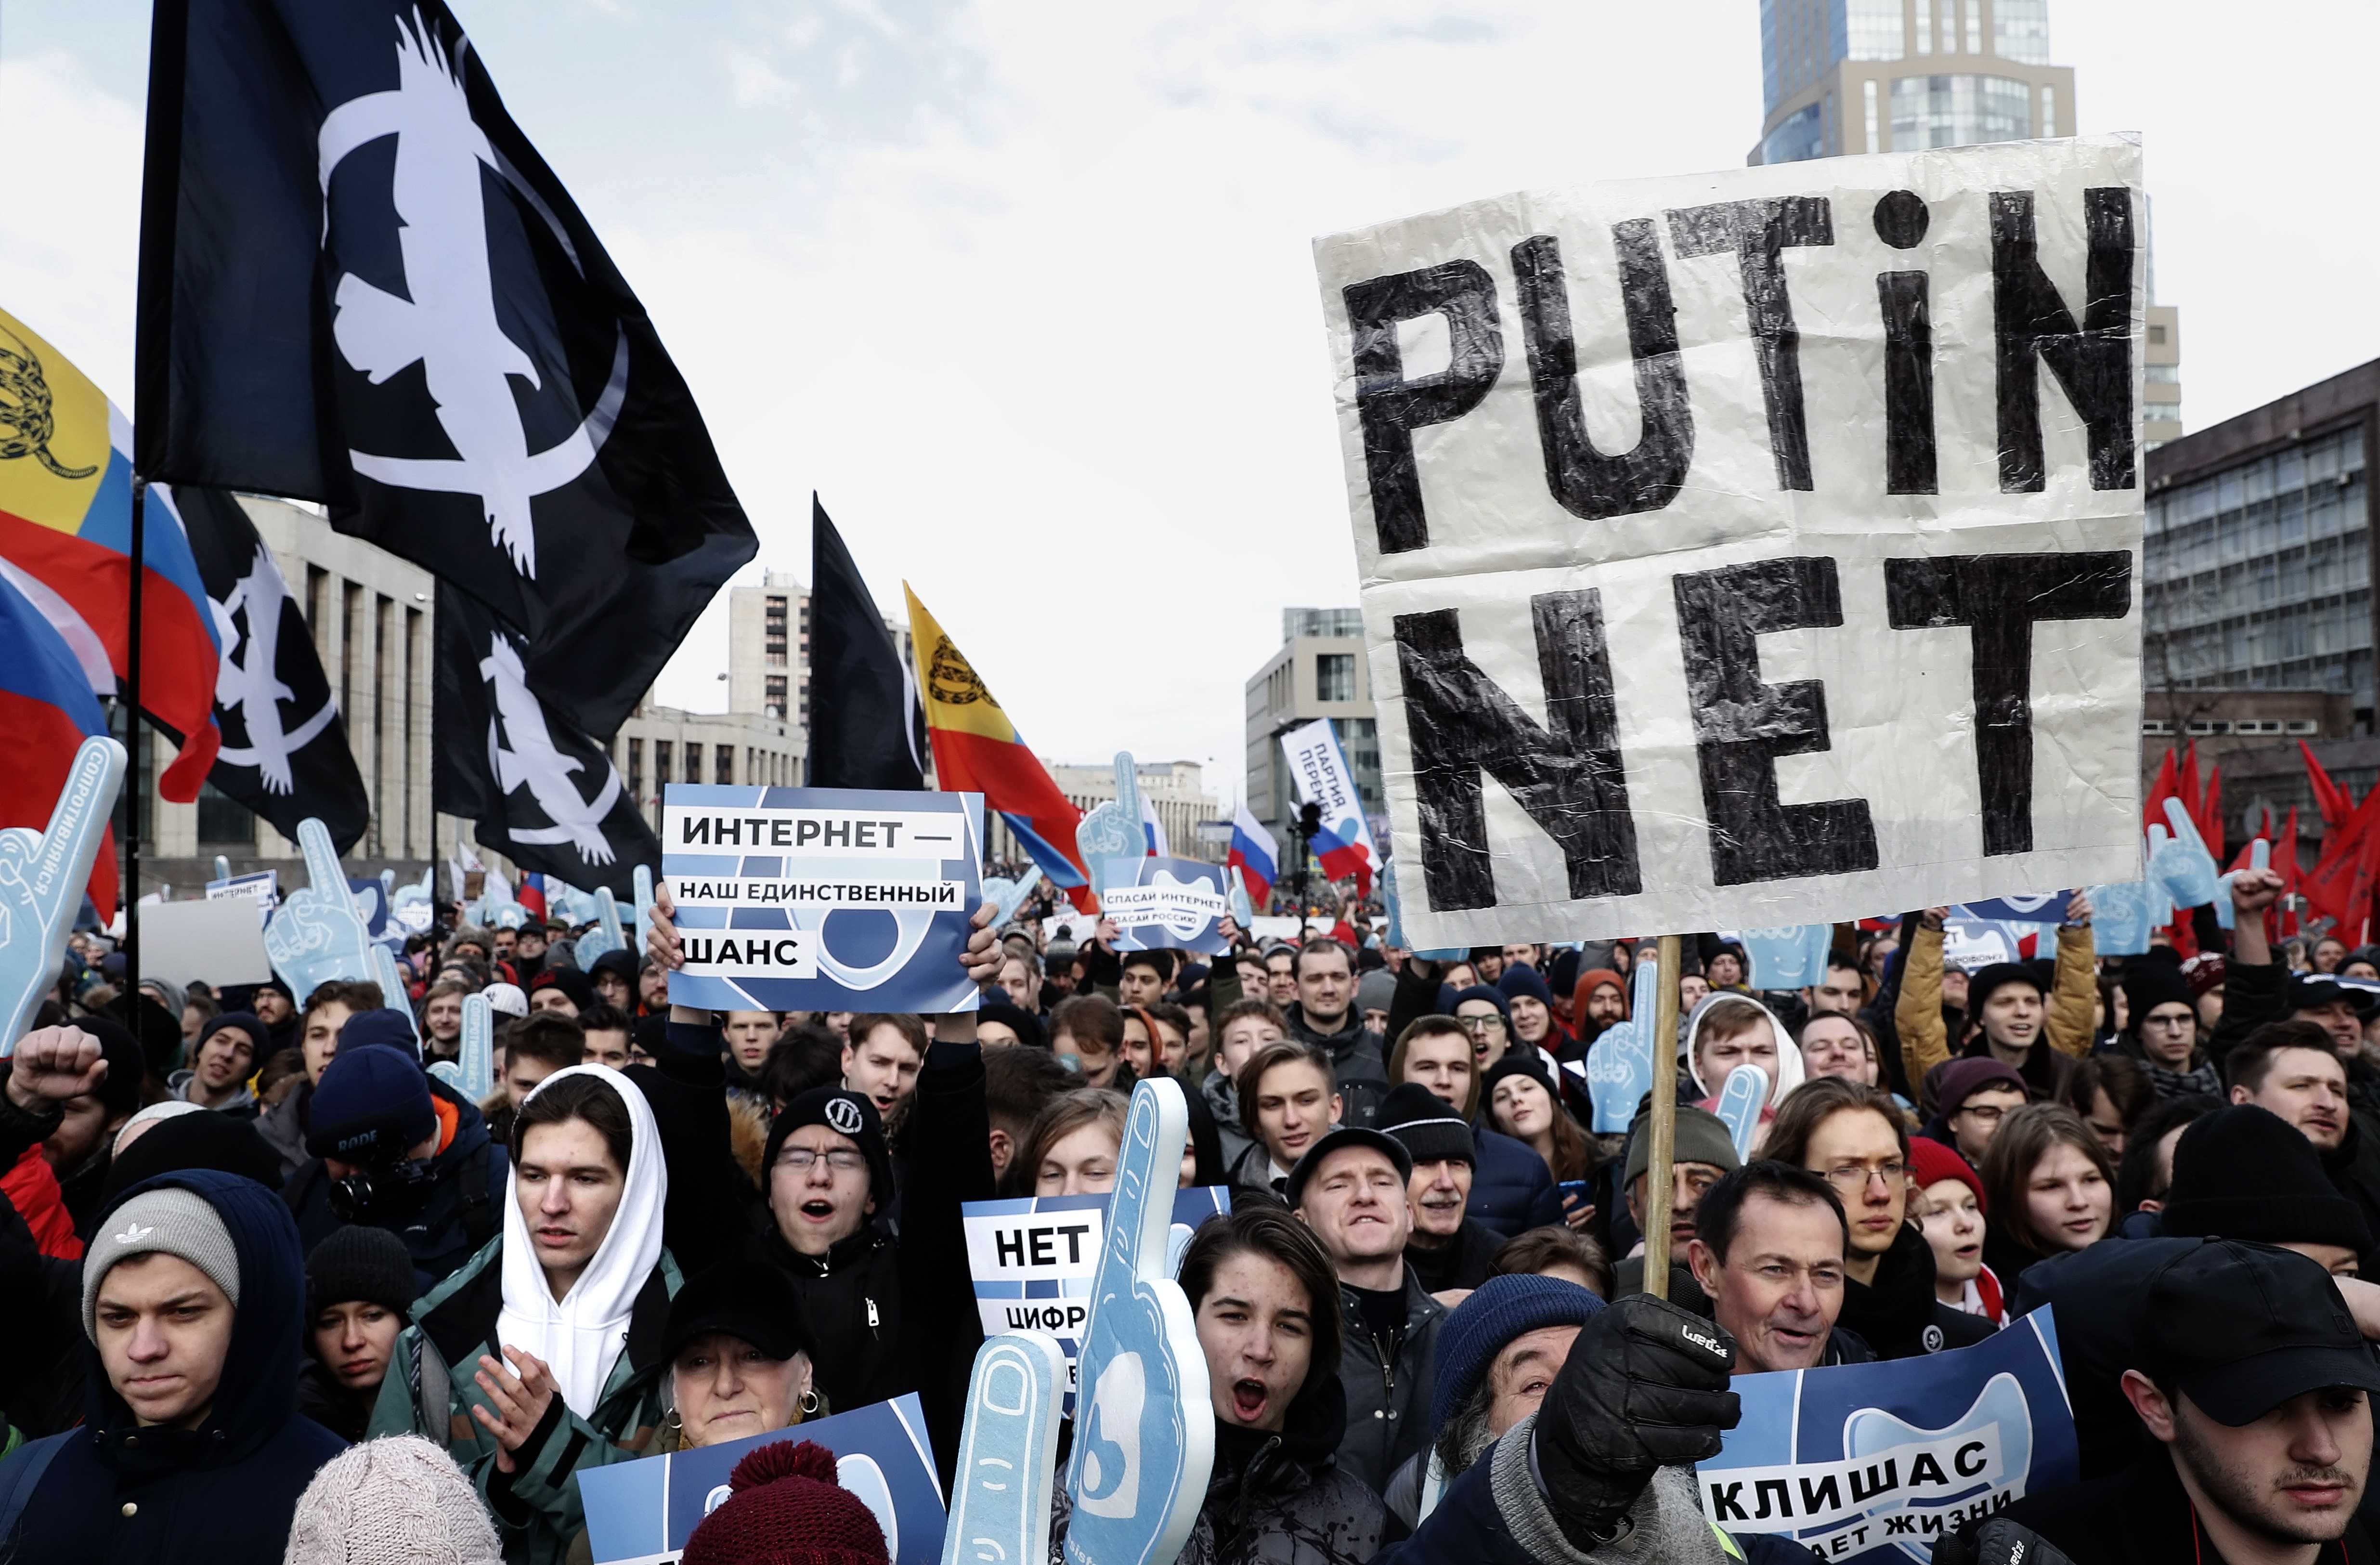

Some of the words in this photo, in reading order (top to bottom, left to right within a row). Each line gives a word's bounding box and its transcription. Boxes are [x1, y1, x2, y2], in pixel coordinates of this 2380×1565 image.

[1392, 549, 2132, 912] NET
[1300, 749, 1335, 822] ПЕРЕМЕН
[1315, 743, 1346, 808] ПАРТИЯ
[34, 751, 104, 896] СОПРОТИВЛЯЙСЯ
[683, 817, 903, 848] ИНТЕРНЕТ
[679, 882, 739, 899] НАШ
[747, 883, 955, 903] ЕДИНСТВЕННЫЙ
[1107, 893, 1156, 904] СПАСАЙ
[1161, 893, 1222, 910] ИНТЕРНЕТ
[1108, 914, 1149, 923] ПАСАЙ
[1153, 913, 1197, 924] РОССИЮ
[681, 938, 798, 965] ШАНС
[995, 1225, 1089, 1266] НЕТ
[1006, 1306, 1086, 1330] ЦИФР
[1710, 1441, 1988, 1522] КЛИШАС
[1810, 1525, 1869, 1560] АЕТ
[1884, 1490, 2012, 1536] ЖИЗНИ
